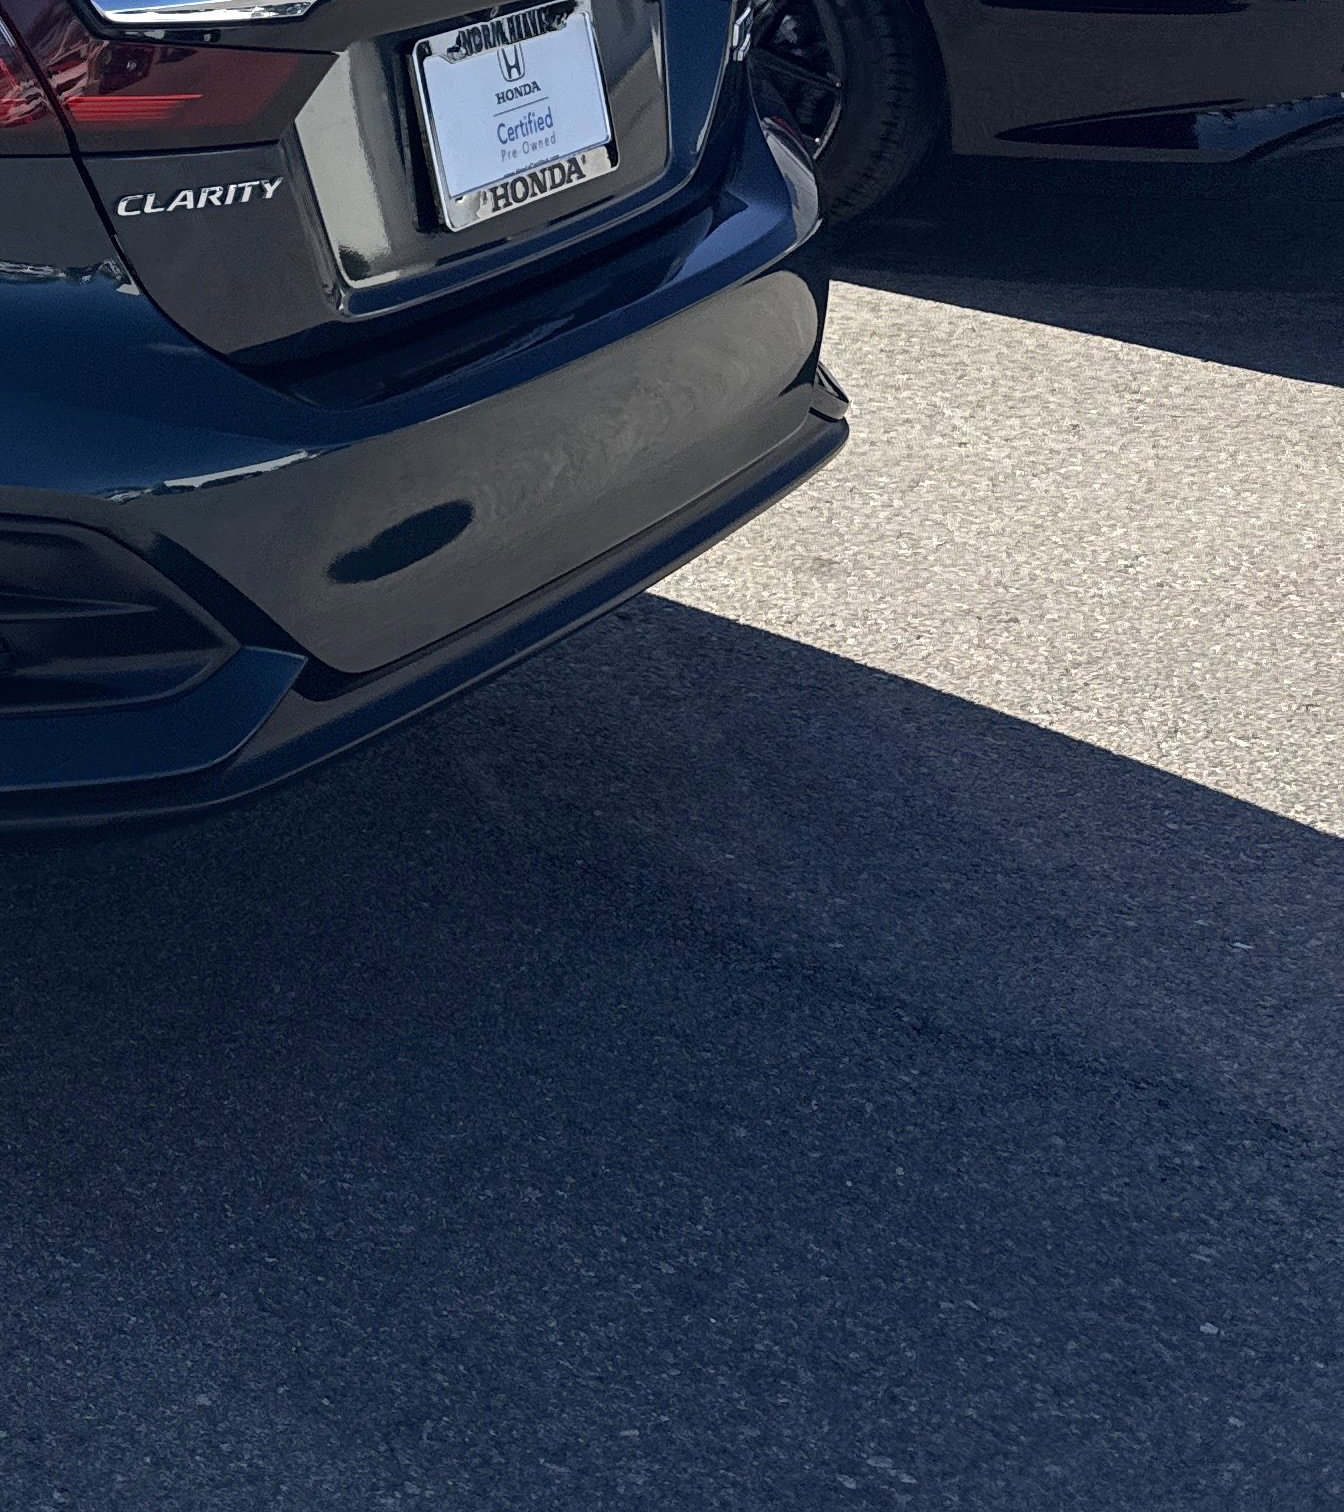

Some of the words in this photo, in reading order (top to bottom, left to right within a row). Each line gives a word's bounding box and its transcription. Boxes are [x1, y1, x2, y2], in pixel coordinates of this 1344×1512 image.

[495, 80, 541, 104] HONDA
[497, 106, 554, 145] Certified
[117, 177, 284, 217] CLARITY
[490, 156, 586, 212] HONDA
